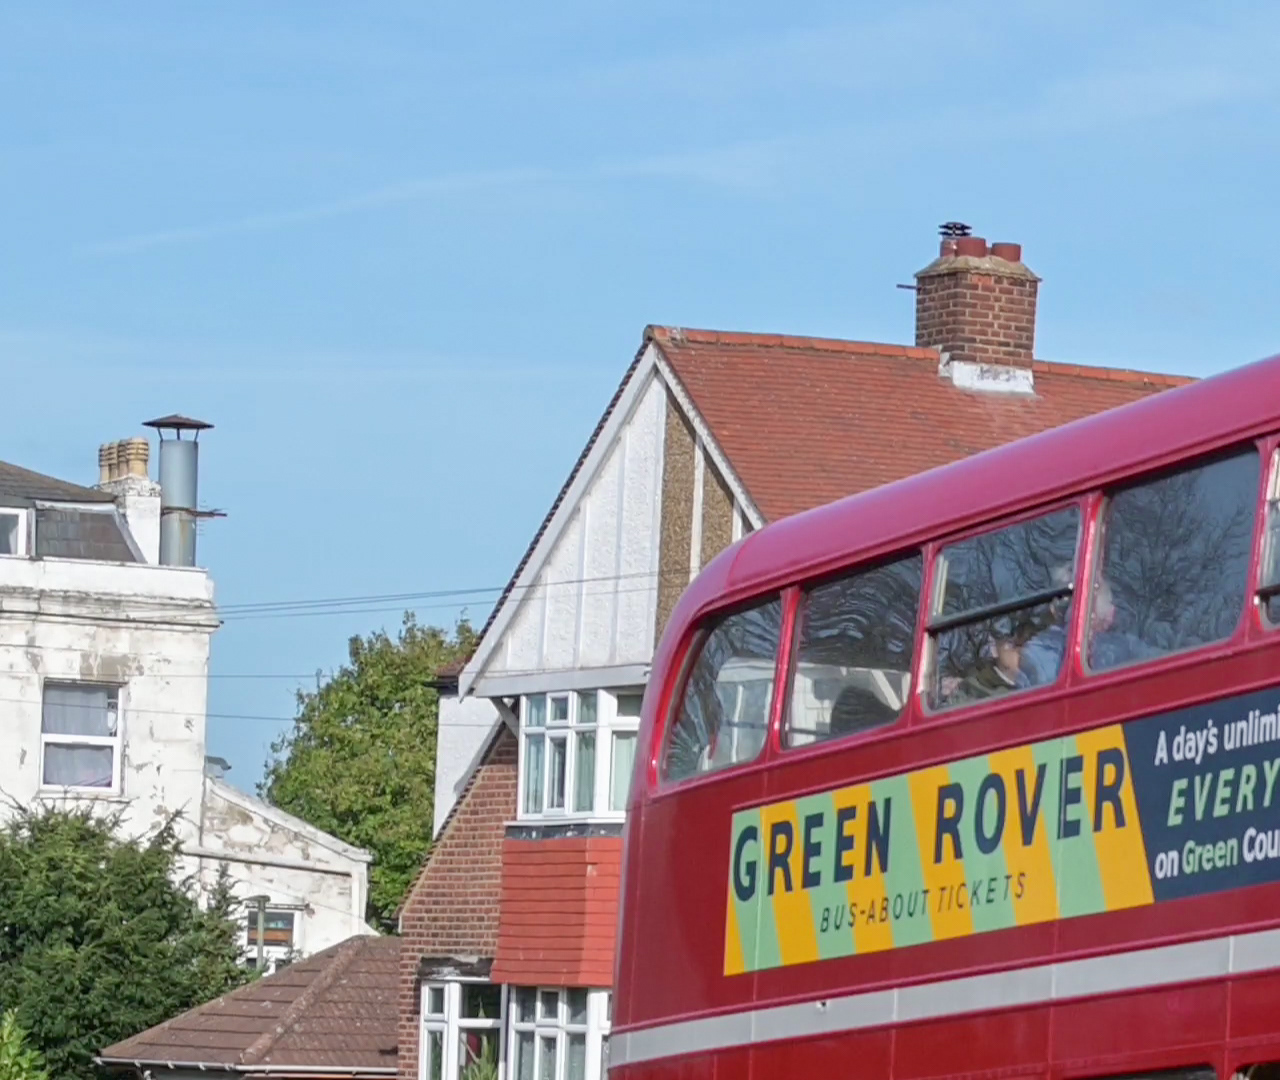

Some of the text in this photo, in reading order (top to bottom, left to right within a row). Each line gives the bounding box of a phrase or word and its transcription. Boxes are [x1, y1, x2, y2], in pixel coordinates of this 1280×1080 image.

[1154, 730, 1169, 766] A
[1172, 719, 1218, 765] day's
[733, 747, 1126, 902] GREEN ROVER
[1154, 850, 1179, 879] on
[1182, 837, 1239, 875] Green
[820, 872, 1028, 933] BUS-ABOUT TICKETS
